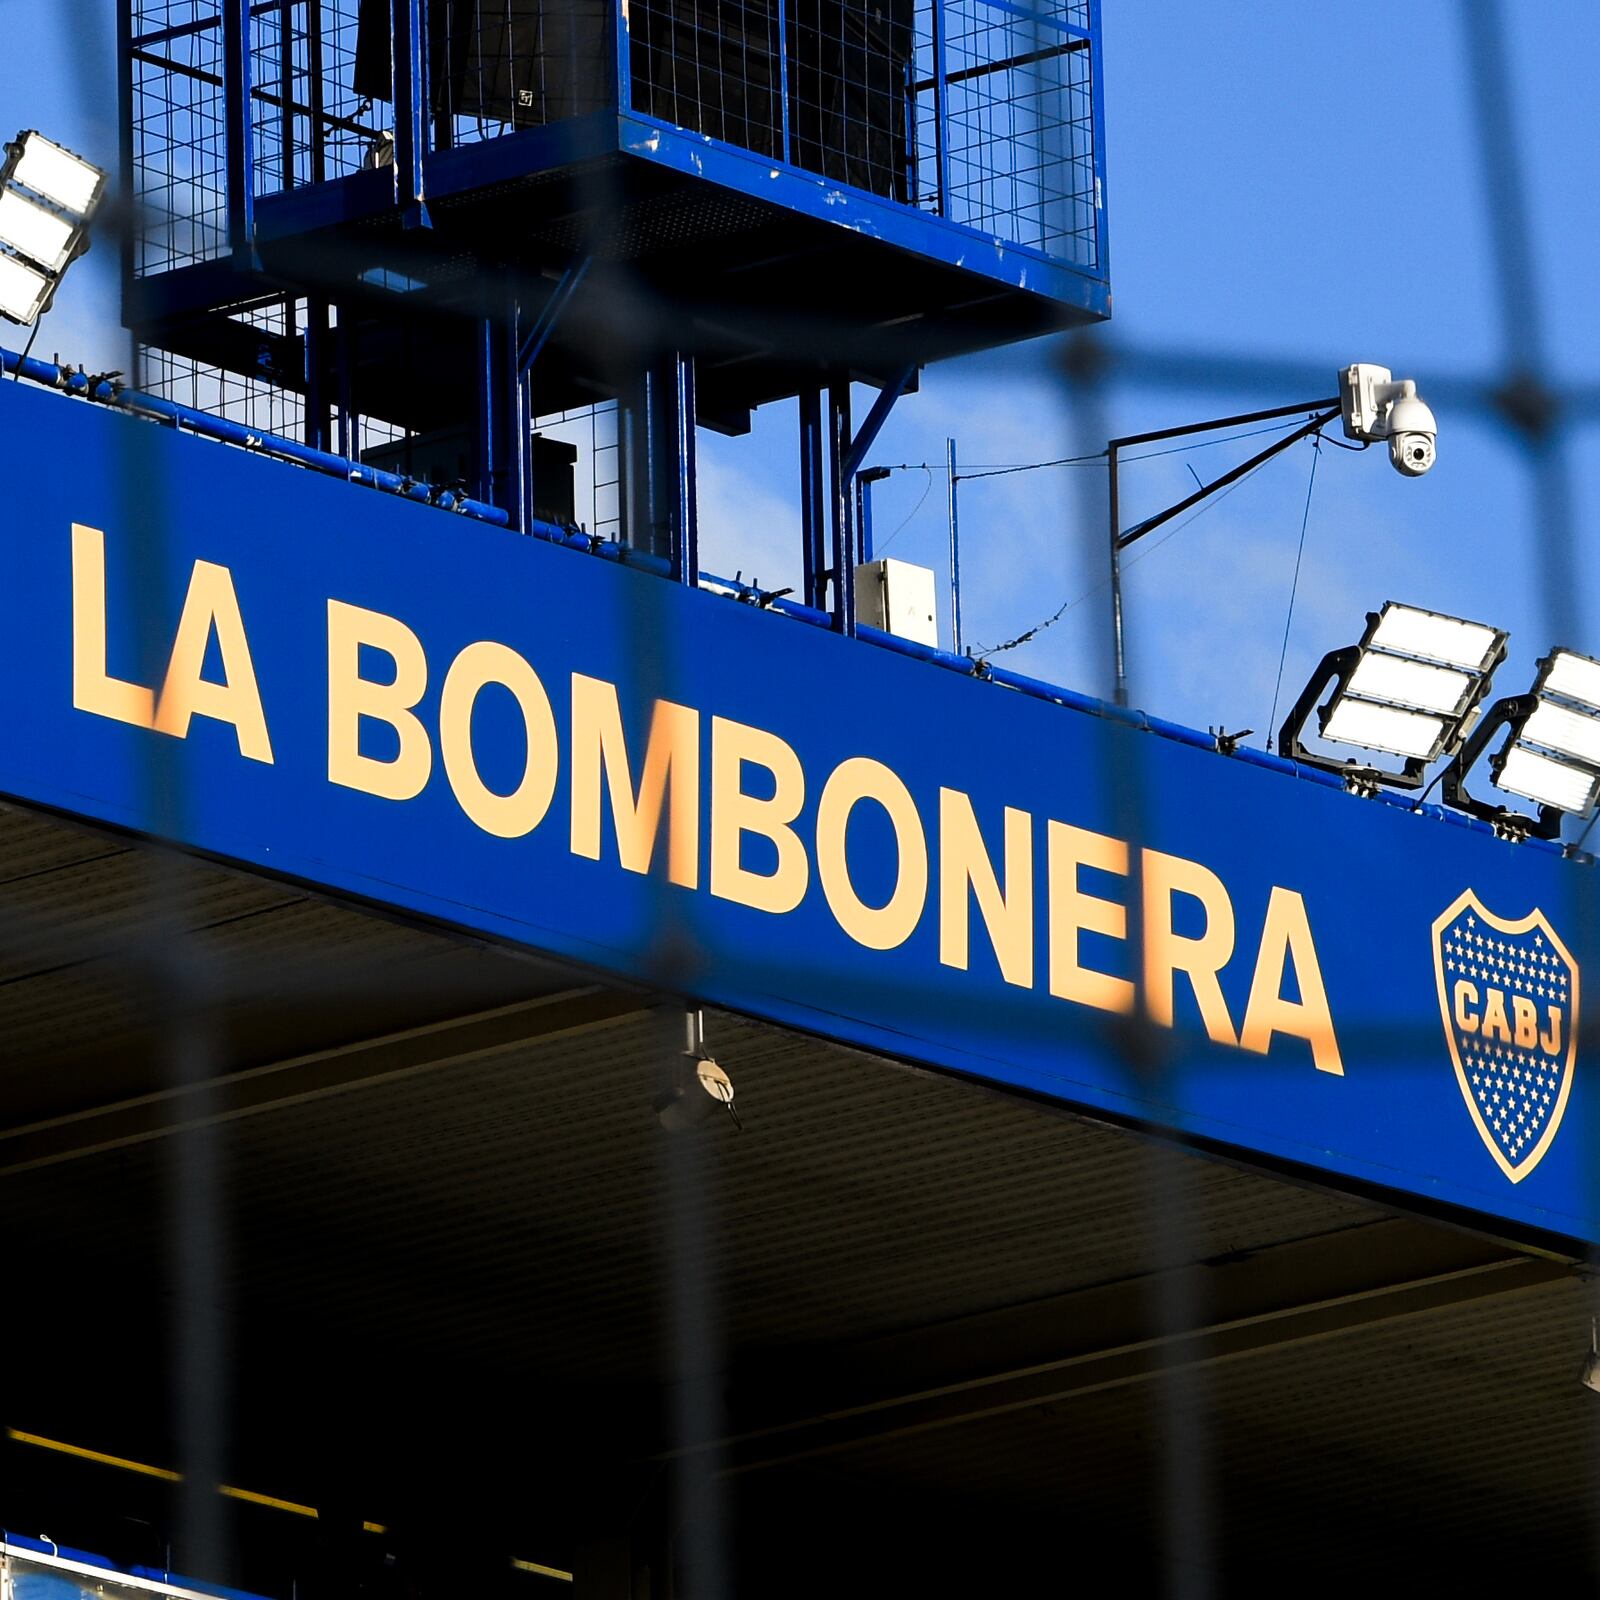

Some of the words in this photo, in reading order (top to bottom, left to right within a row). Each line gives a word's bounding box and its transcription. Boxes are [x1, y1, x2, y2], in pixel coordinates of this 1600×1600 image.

[71, 522, 275, 765] LA
[327, 598, 1346, 1077] BOMBONERA
[1453, 979, 1562, 1057] CABJ
